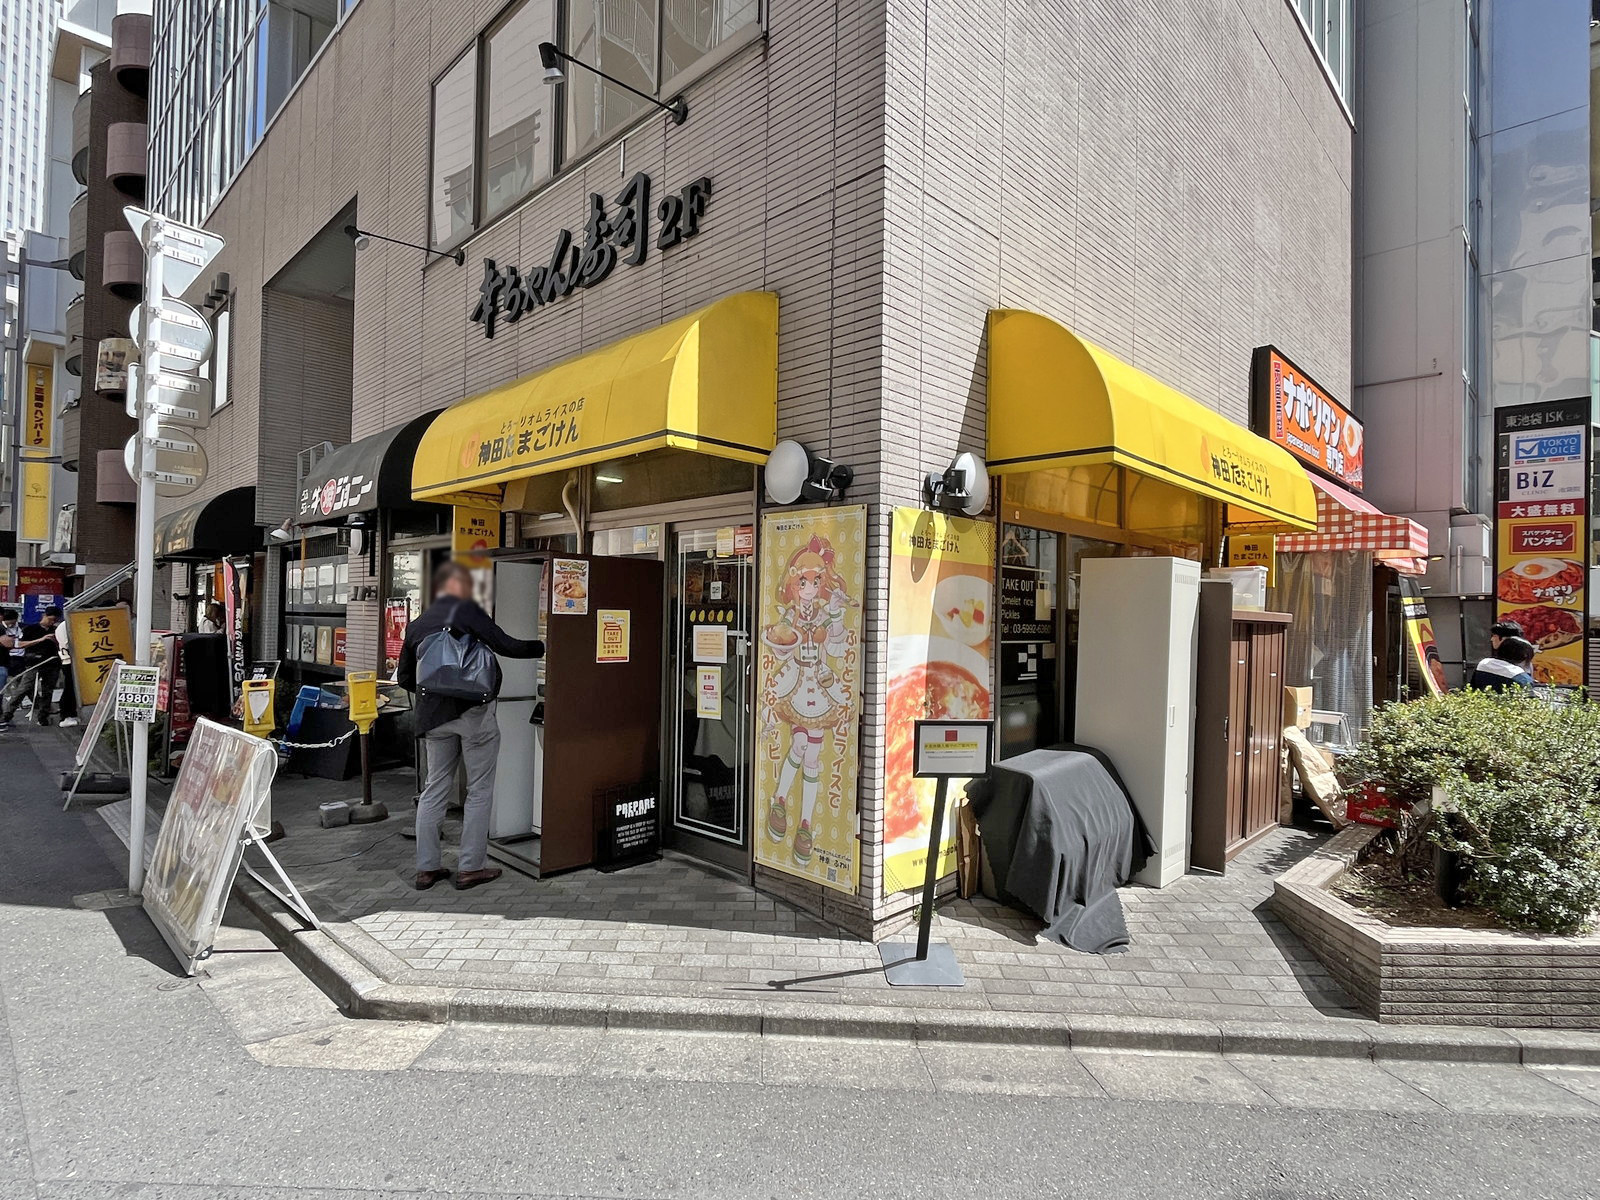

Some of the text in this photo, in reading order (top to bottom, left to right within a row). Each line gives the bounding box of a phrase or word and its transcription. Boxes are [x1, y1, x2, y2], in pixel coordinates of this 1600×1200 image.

[657, 177, 712, 251] 2F
[1283, 372, 1341, 448] ナポリタン
[1506, 411, 1542, 428] 東池袋
[1545, 410, 1564, 423] ISK
[1542, 437, 1577, 447] TOKYO
[1542, 446, 1576, 455] VOICE
[1211, 453, 1272, 499] 神田たまごけん
[1511, 503, 1576, 518] 大盛無料
[1002, 578, 1034, 592] TAKE OUT
[1532, 584, 1573, 598] ナポリ
[763, 655, 781, 779] みんなハッピー
[616, 797, 655, 816] PREPARE
